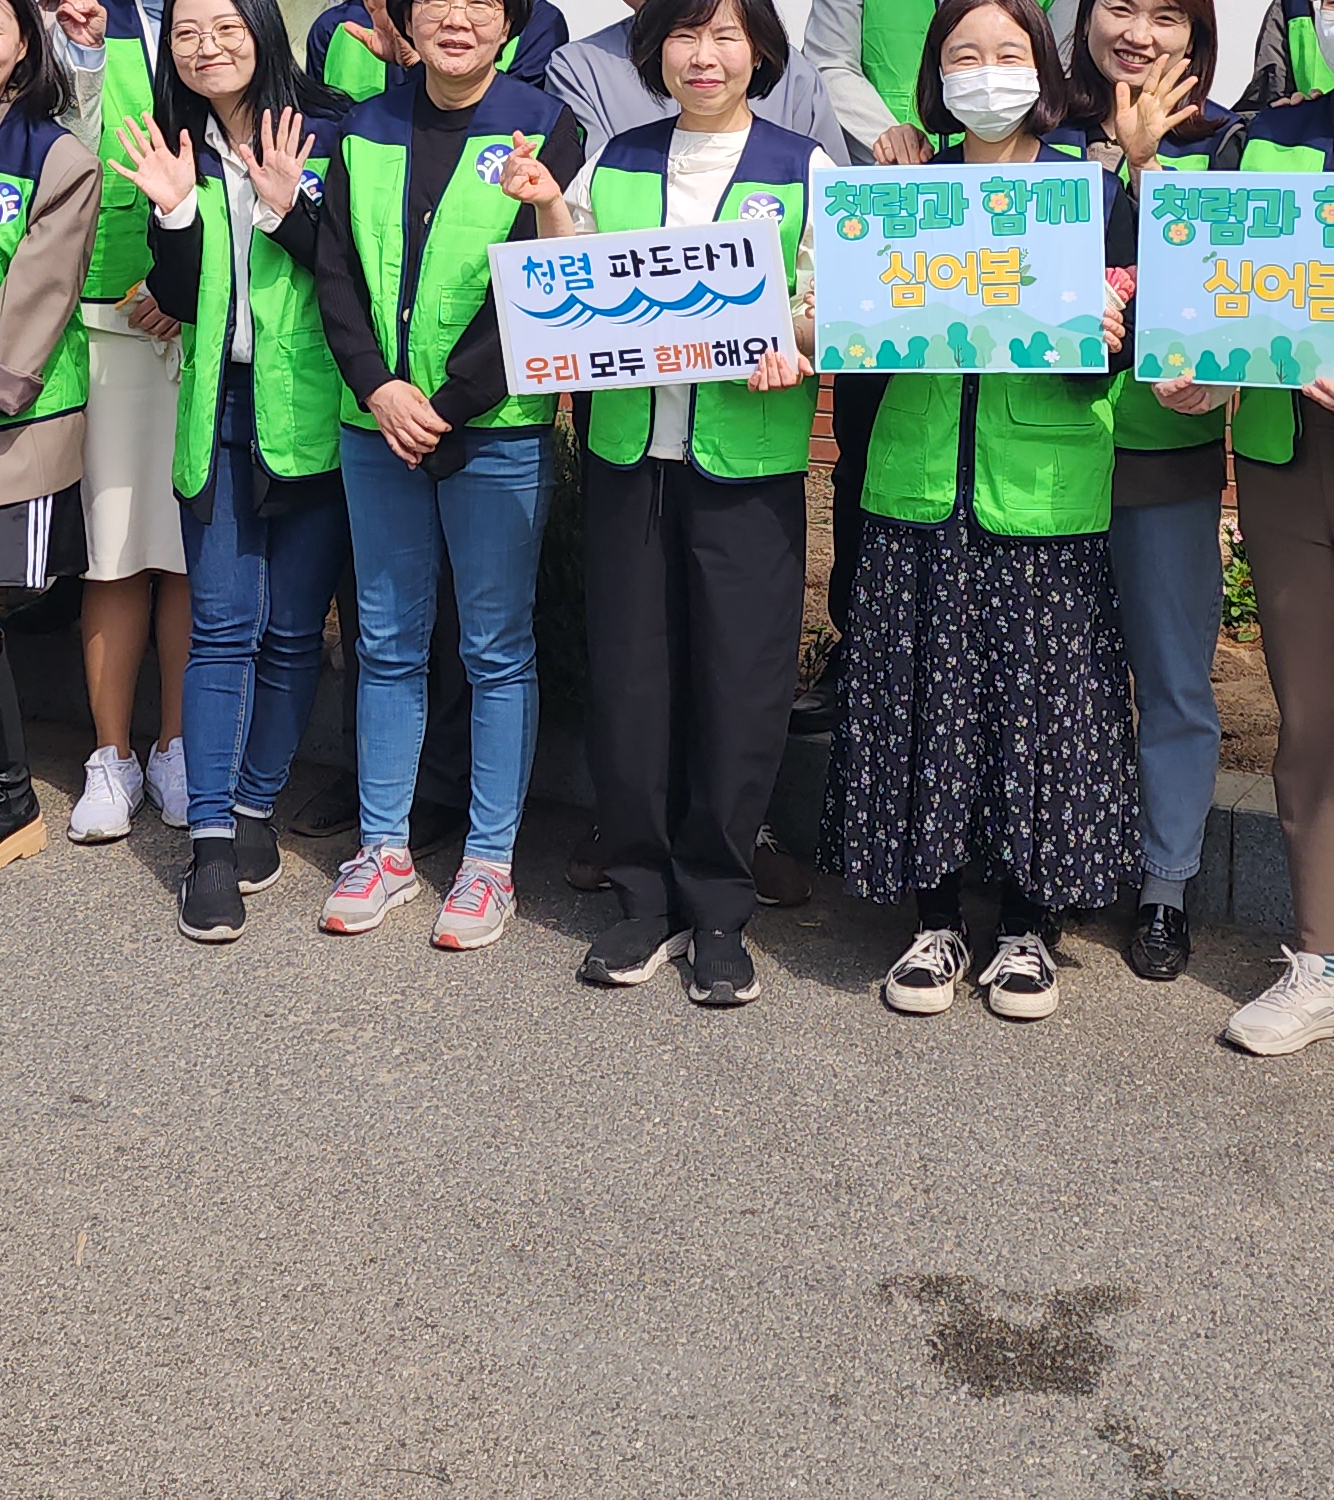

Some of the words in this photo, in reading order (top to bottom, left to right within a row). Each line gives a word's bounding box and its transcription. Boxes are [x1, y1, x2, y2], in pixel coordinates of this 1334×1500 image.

[825, 180, 969, 241] 청렴과
[980, 176, 1091, 237] 함께
[1151, 183, 1301, 246] 청렴과
[522, 253, 594, 295] 청렴
[608, 238, 755, 278] 파도타기
[879, 247, 1021, 308] 심어봄
[525, 353, 580, 384] 우리
[589, 348, 645, 379] 모두
